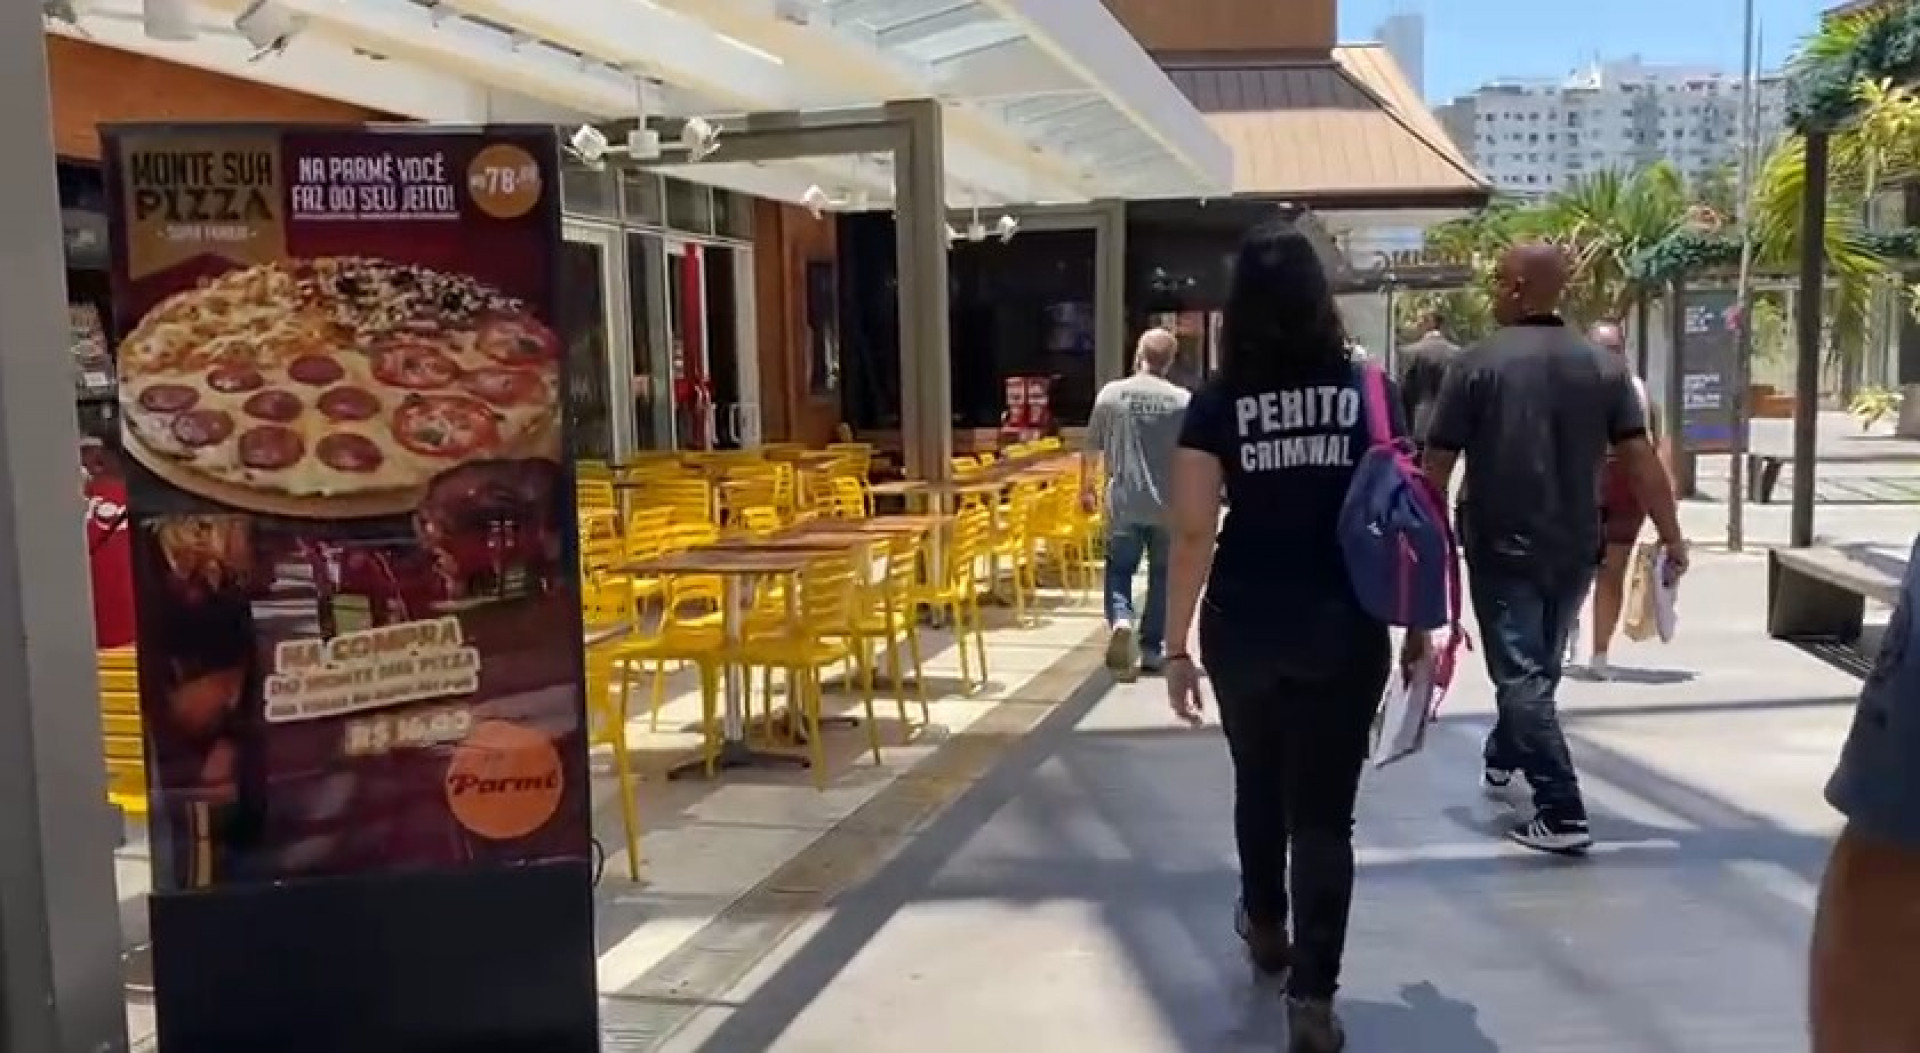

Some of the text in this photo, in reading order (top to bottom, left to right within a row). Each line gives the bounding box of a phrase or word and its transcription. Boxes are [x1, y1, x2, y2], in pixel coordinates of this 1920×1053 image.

[132, 152, 273, 185] MONTE SUA
[300, 152, 445, 182] NA PARMÊ VOCÊ
[136, 188, 273, 221] PIZZA
[292, 185, 324, 211] FAZ
[359, 185, 396, 211] SEU
[1236, 386, 1360, 436] PERITO
[1240, 434, 1353, 472] CRIMINAL
[331, 621, 460, 661] COMPRA
